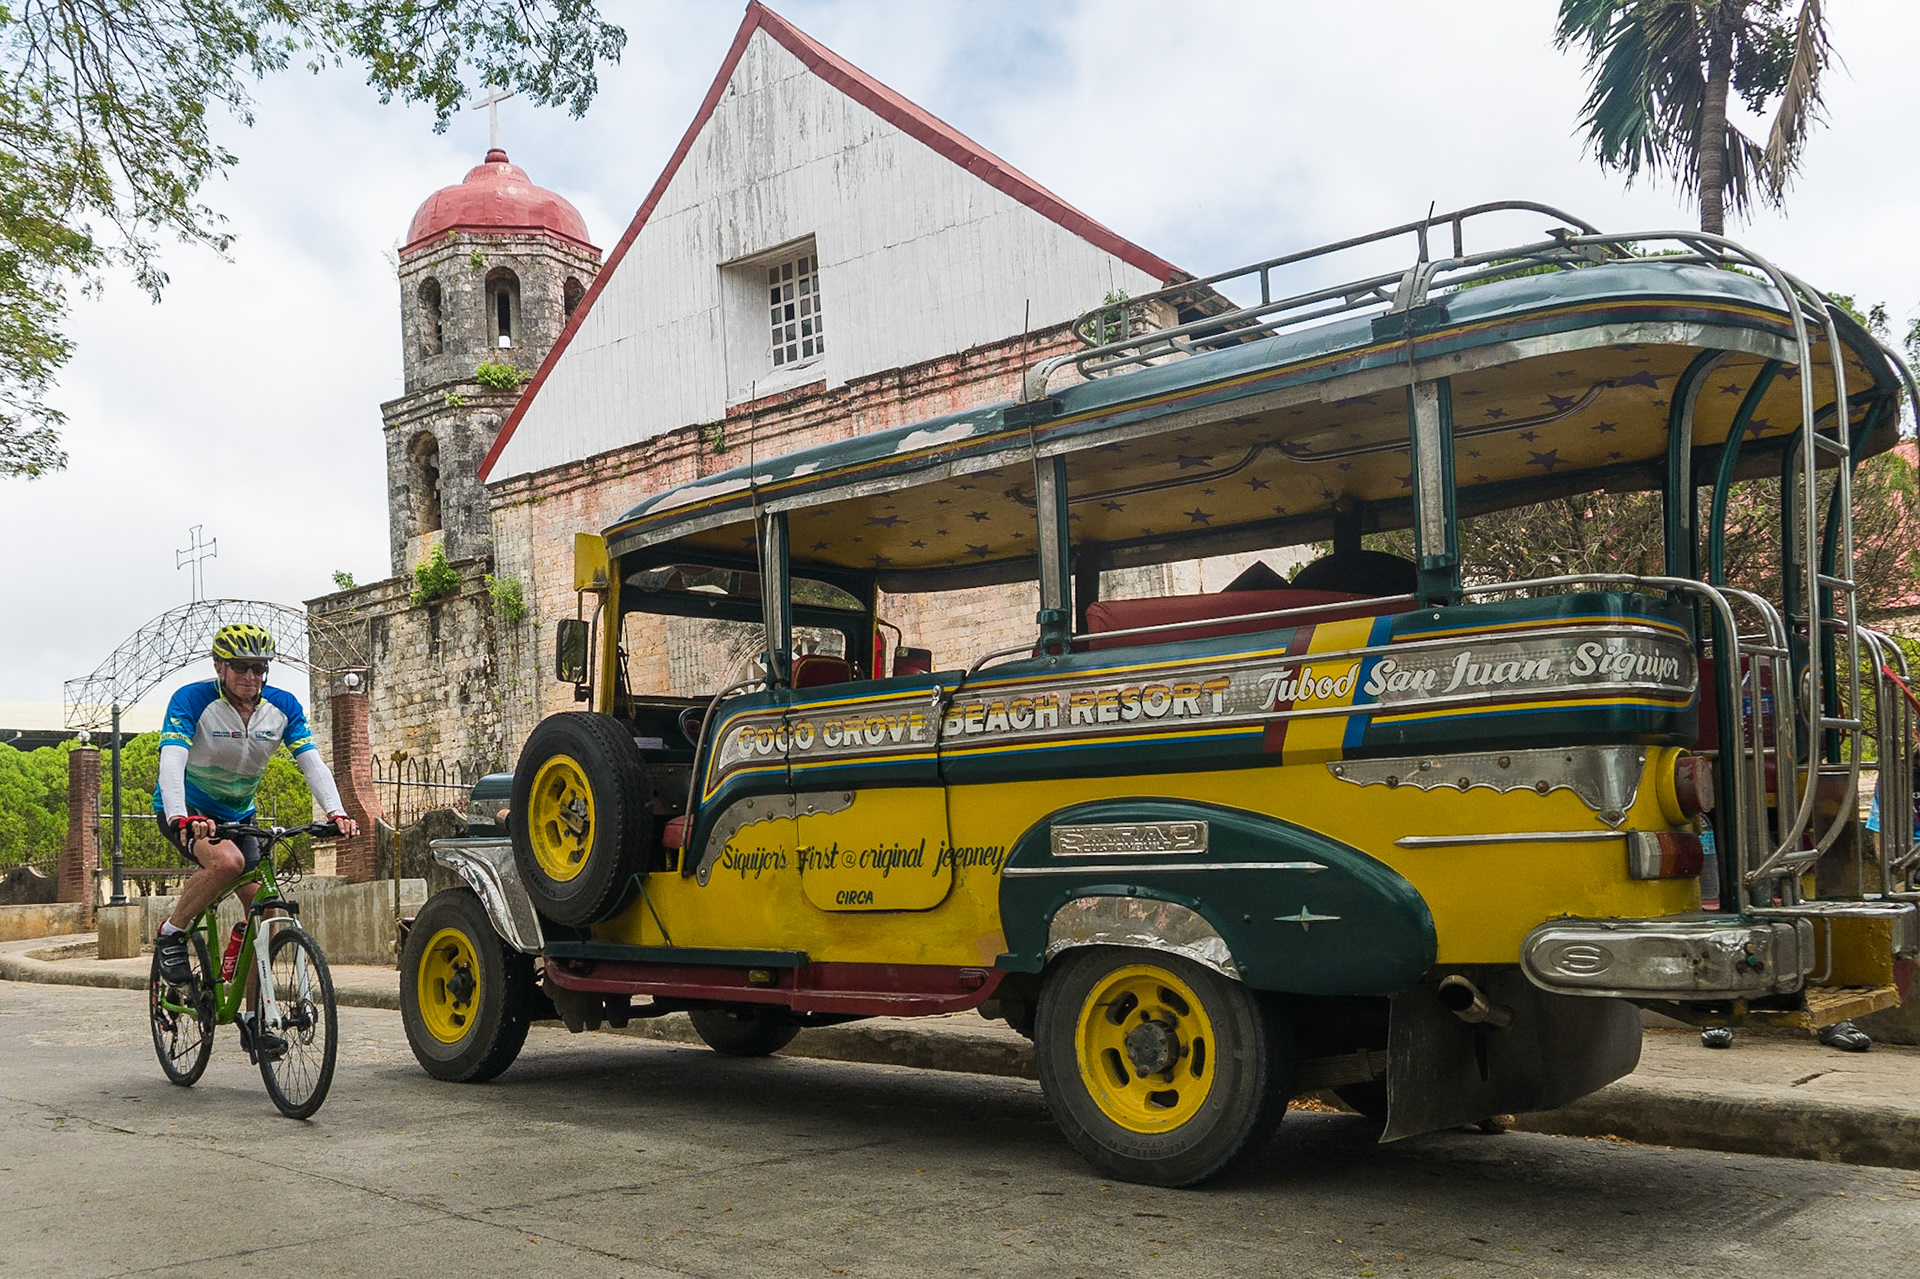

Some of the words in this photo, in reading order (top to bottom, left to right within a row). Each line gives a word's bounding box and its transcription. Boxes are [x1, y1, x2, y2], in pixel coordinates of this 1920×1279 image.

[737, 720, 815, 757] COCO
[823, 713, 926, 748] GROVE
[942, 692, 1059, 736] BEACH
[1257, 662, 1362, 710] Tubod
[1363, 659, 1437, 697] San
[1569, 641, 1680, 682] Siquijor
[722, 844, 787, 879] Siquijor's
[859, 837, 926, 878] original
[931, 840, 1005, 877] jeepney
[835, 889, 874, 905] CIRCA
